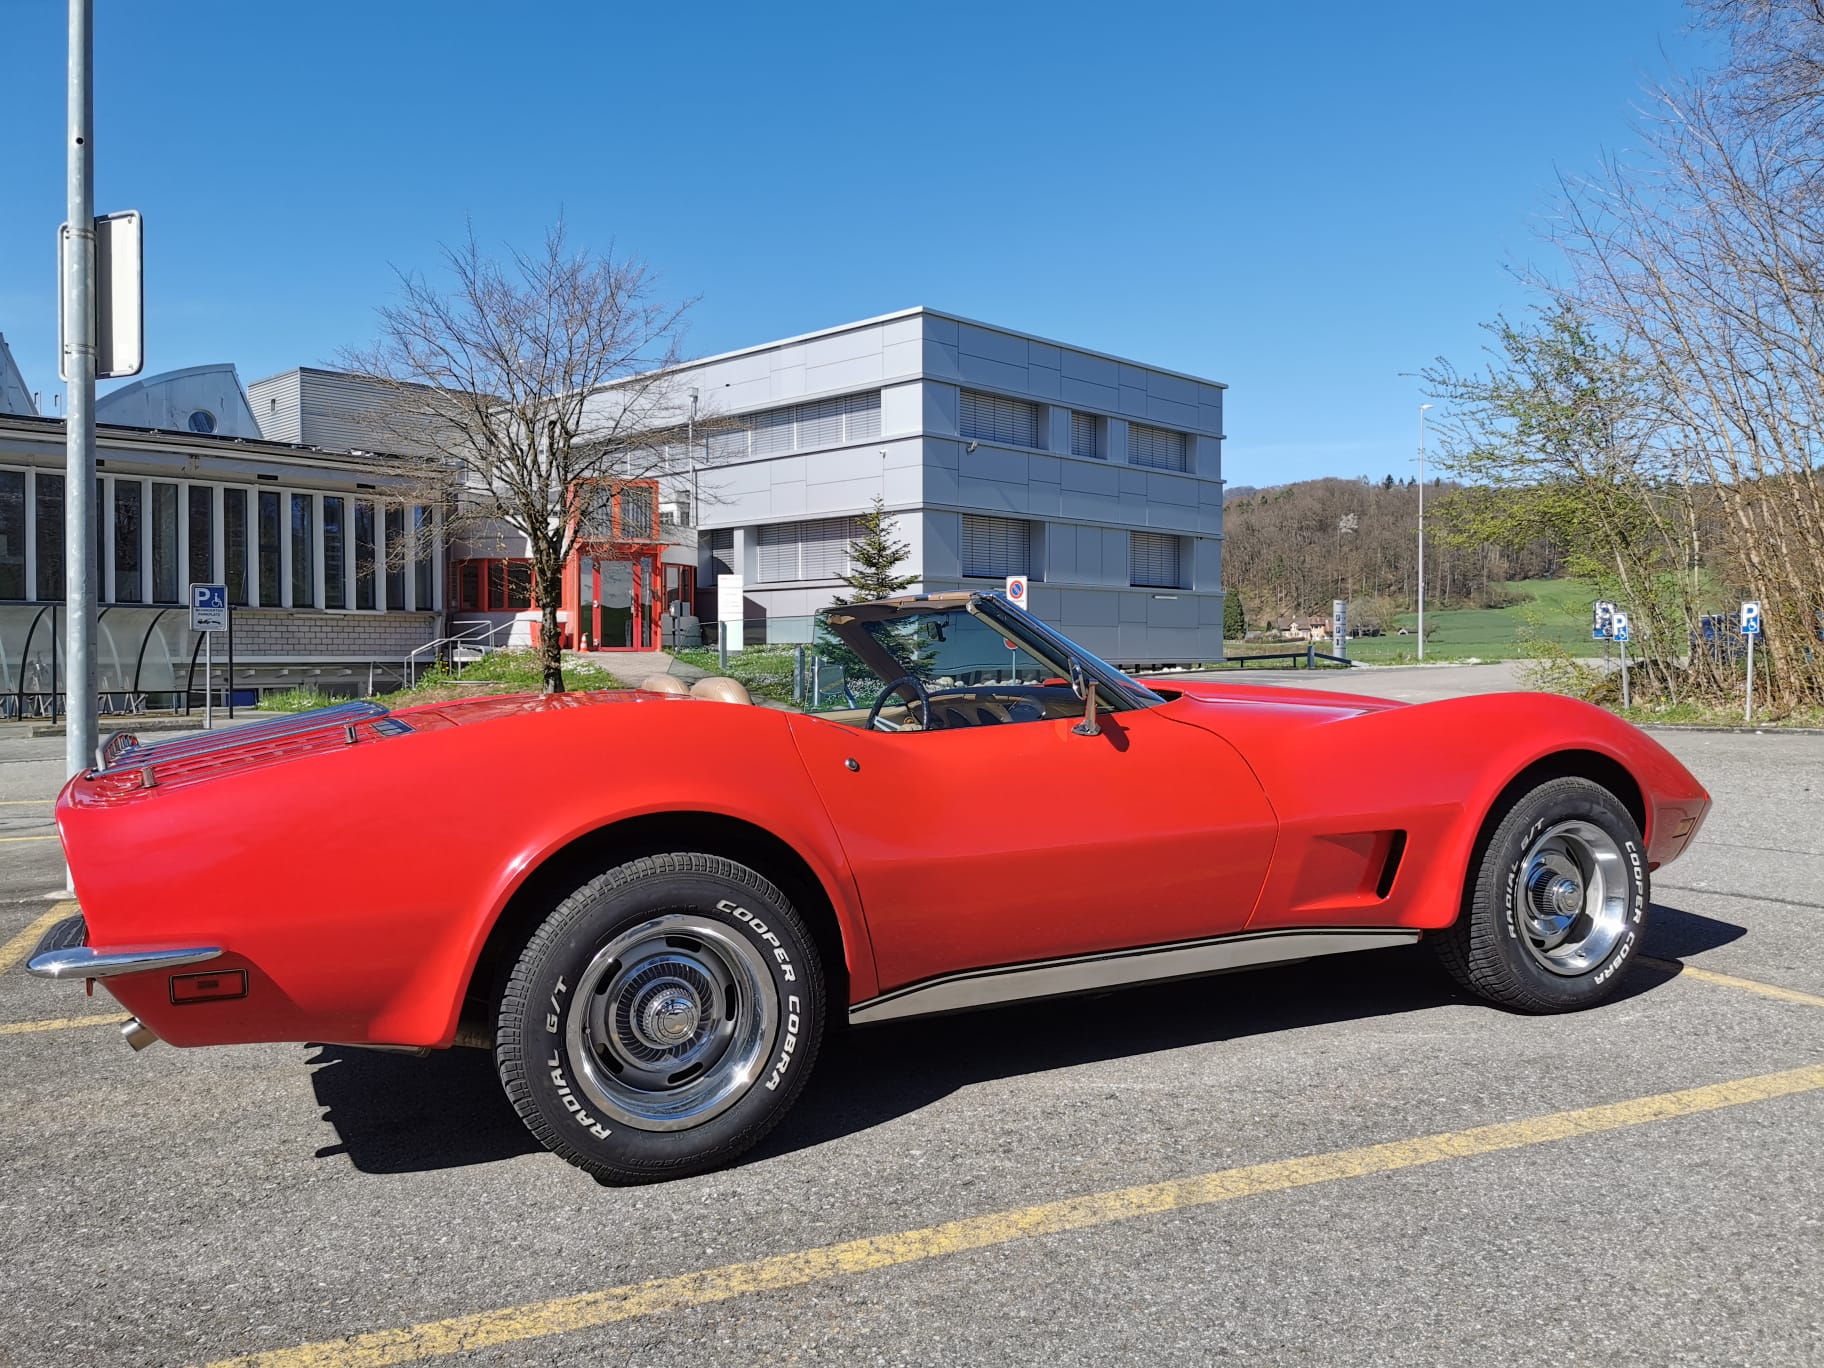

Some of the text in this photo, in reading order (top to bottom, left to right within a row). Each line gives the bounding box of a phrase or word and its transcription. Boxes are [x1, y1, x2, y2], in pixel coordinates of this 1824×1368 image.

[195, 587, 210, 607] P
[1613, 614, 1626, 635] P
[1743, 603, 1757, 627] P
[1506, 817, 1545, 938] RADIAL G/T
[1594, 841, 1643, 985] COOPER COBRA
[716, 900, 800, 1091] COOPER COBRA
[546, 976, 613, 1140] RADIAL G/T
